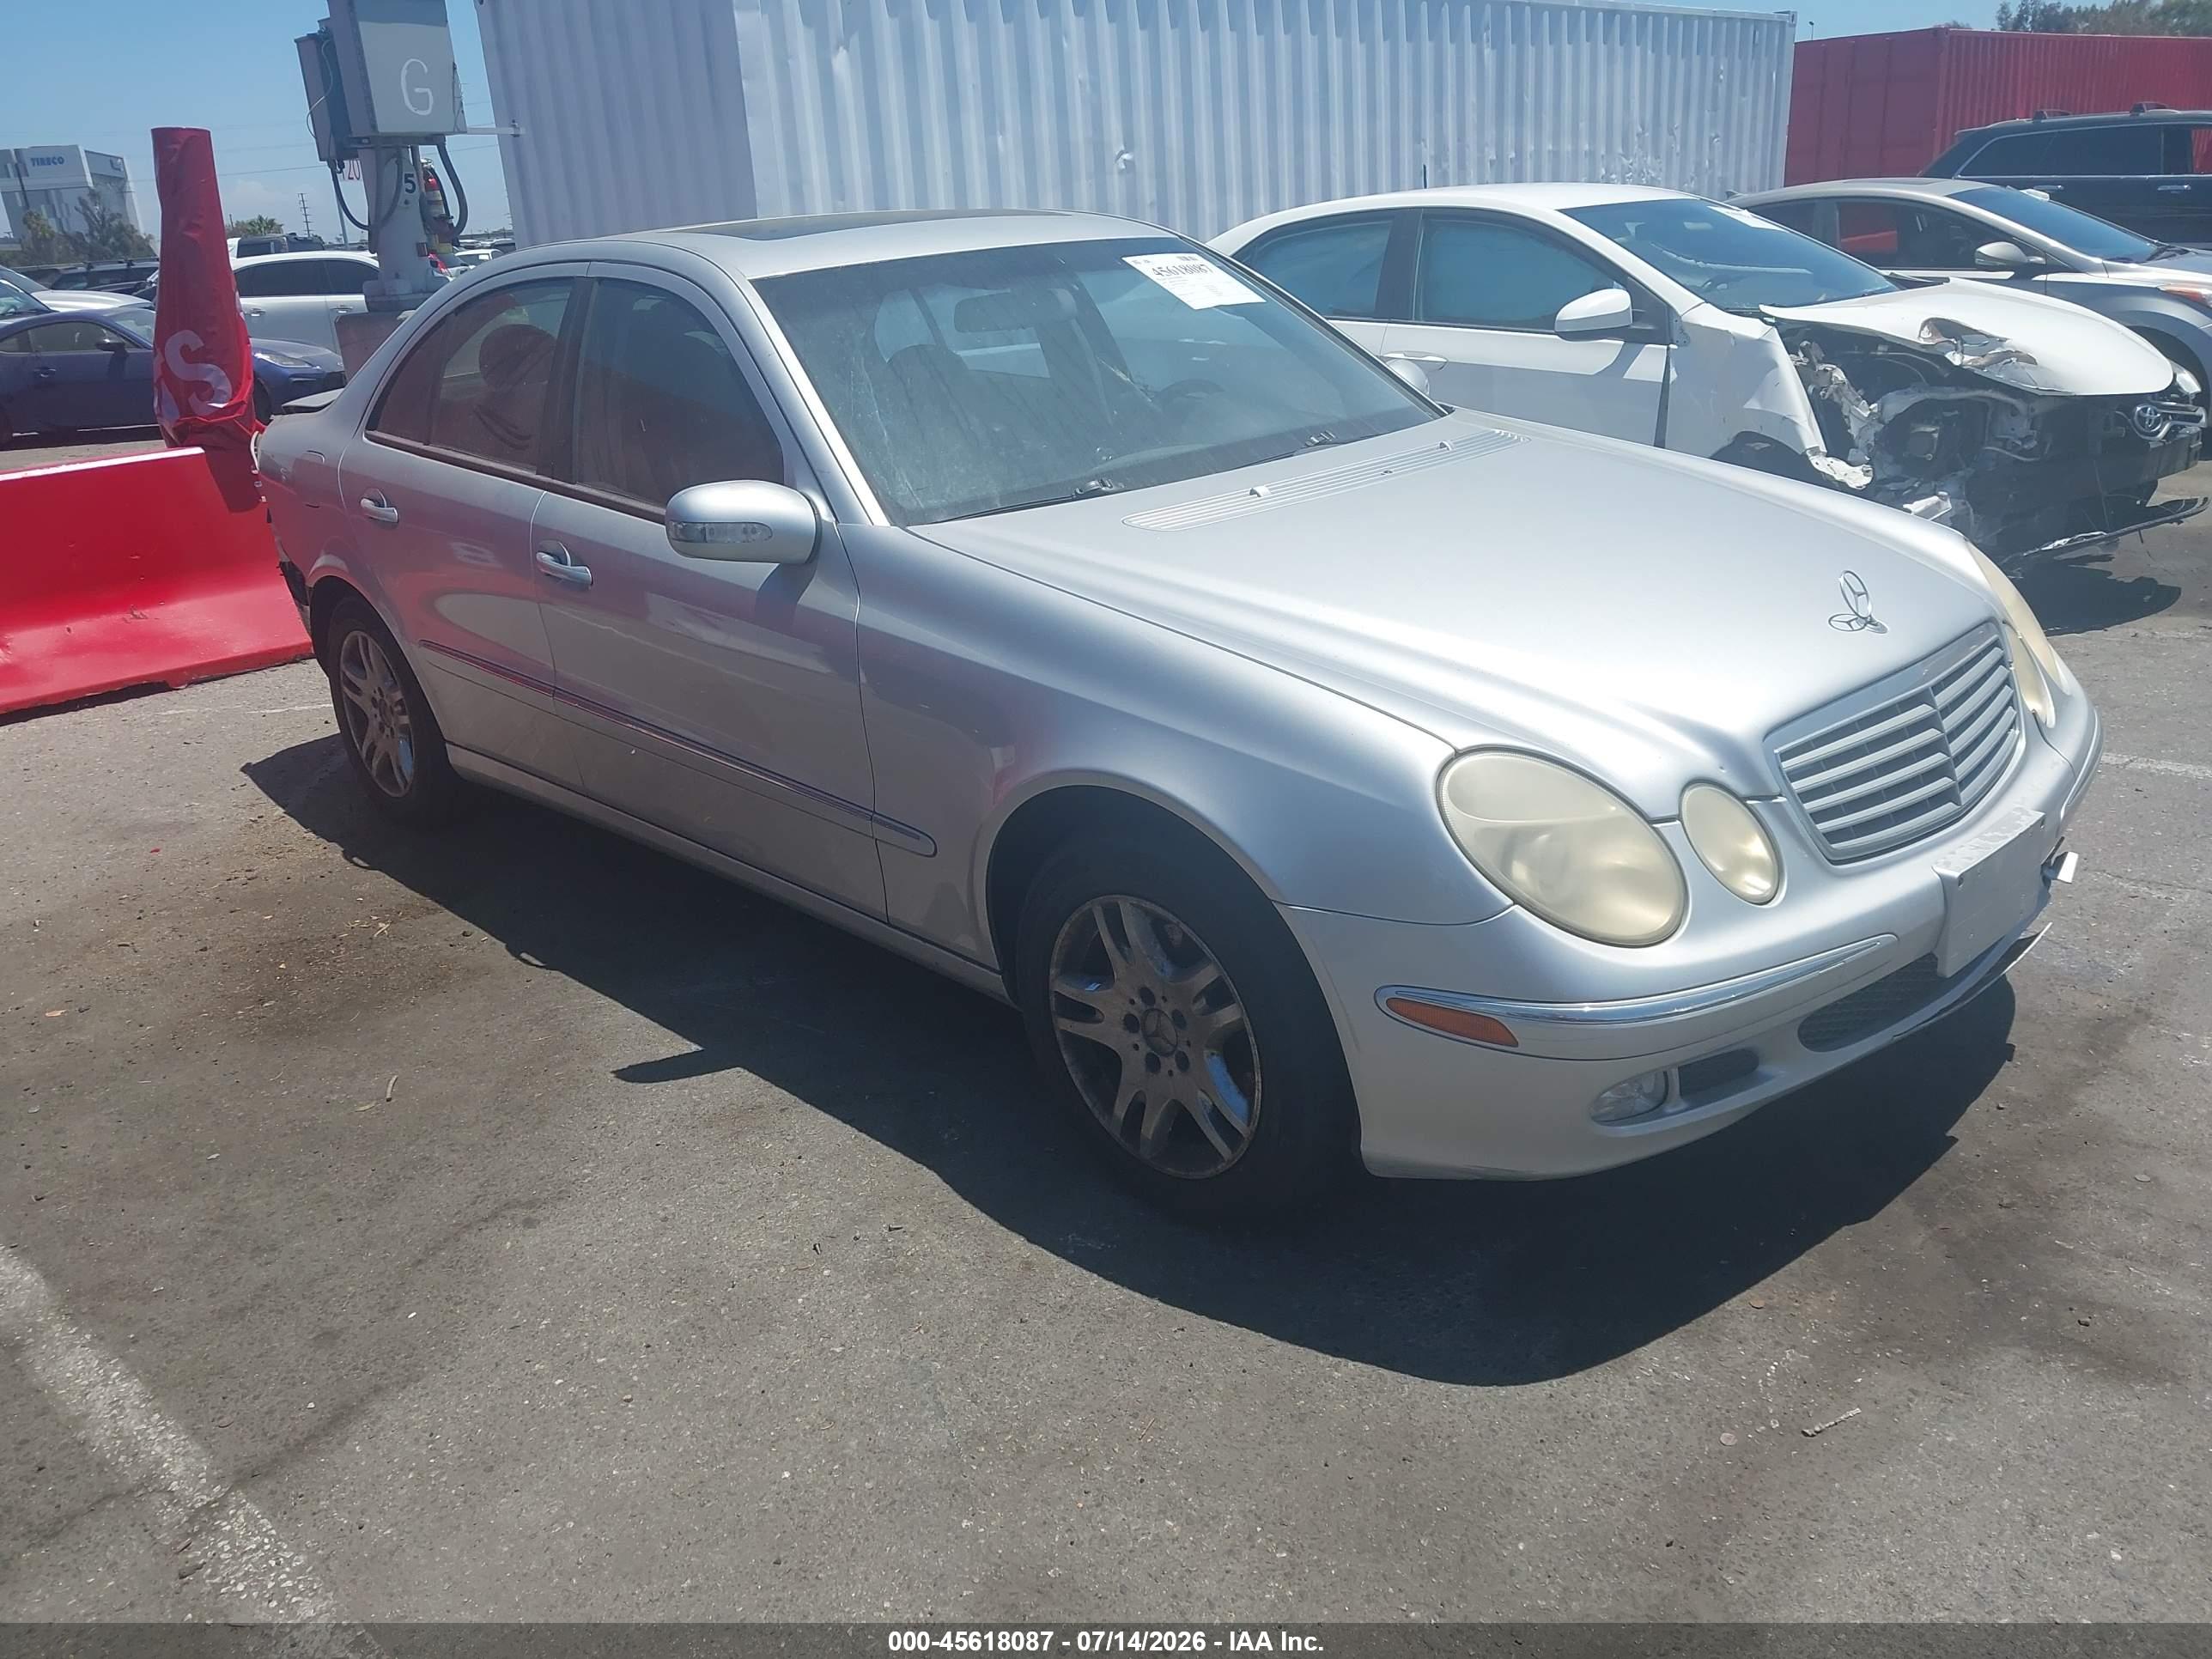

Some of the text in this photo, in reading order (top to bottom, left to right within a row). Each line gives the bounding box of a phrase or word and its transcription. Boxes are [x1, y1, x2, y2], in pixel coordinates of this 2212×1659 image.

[400, 58, 434, 116] G
[404, 173, 416, 194] 5
[1152, 264, 1214, 276] 45618087
[165, 329, 233, 416] S
